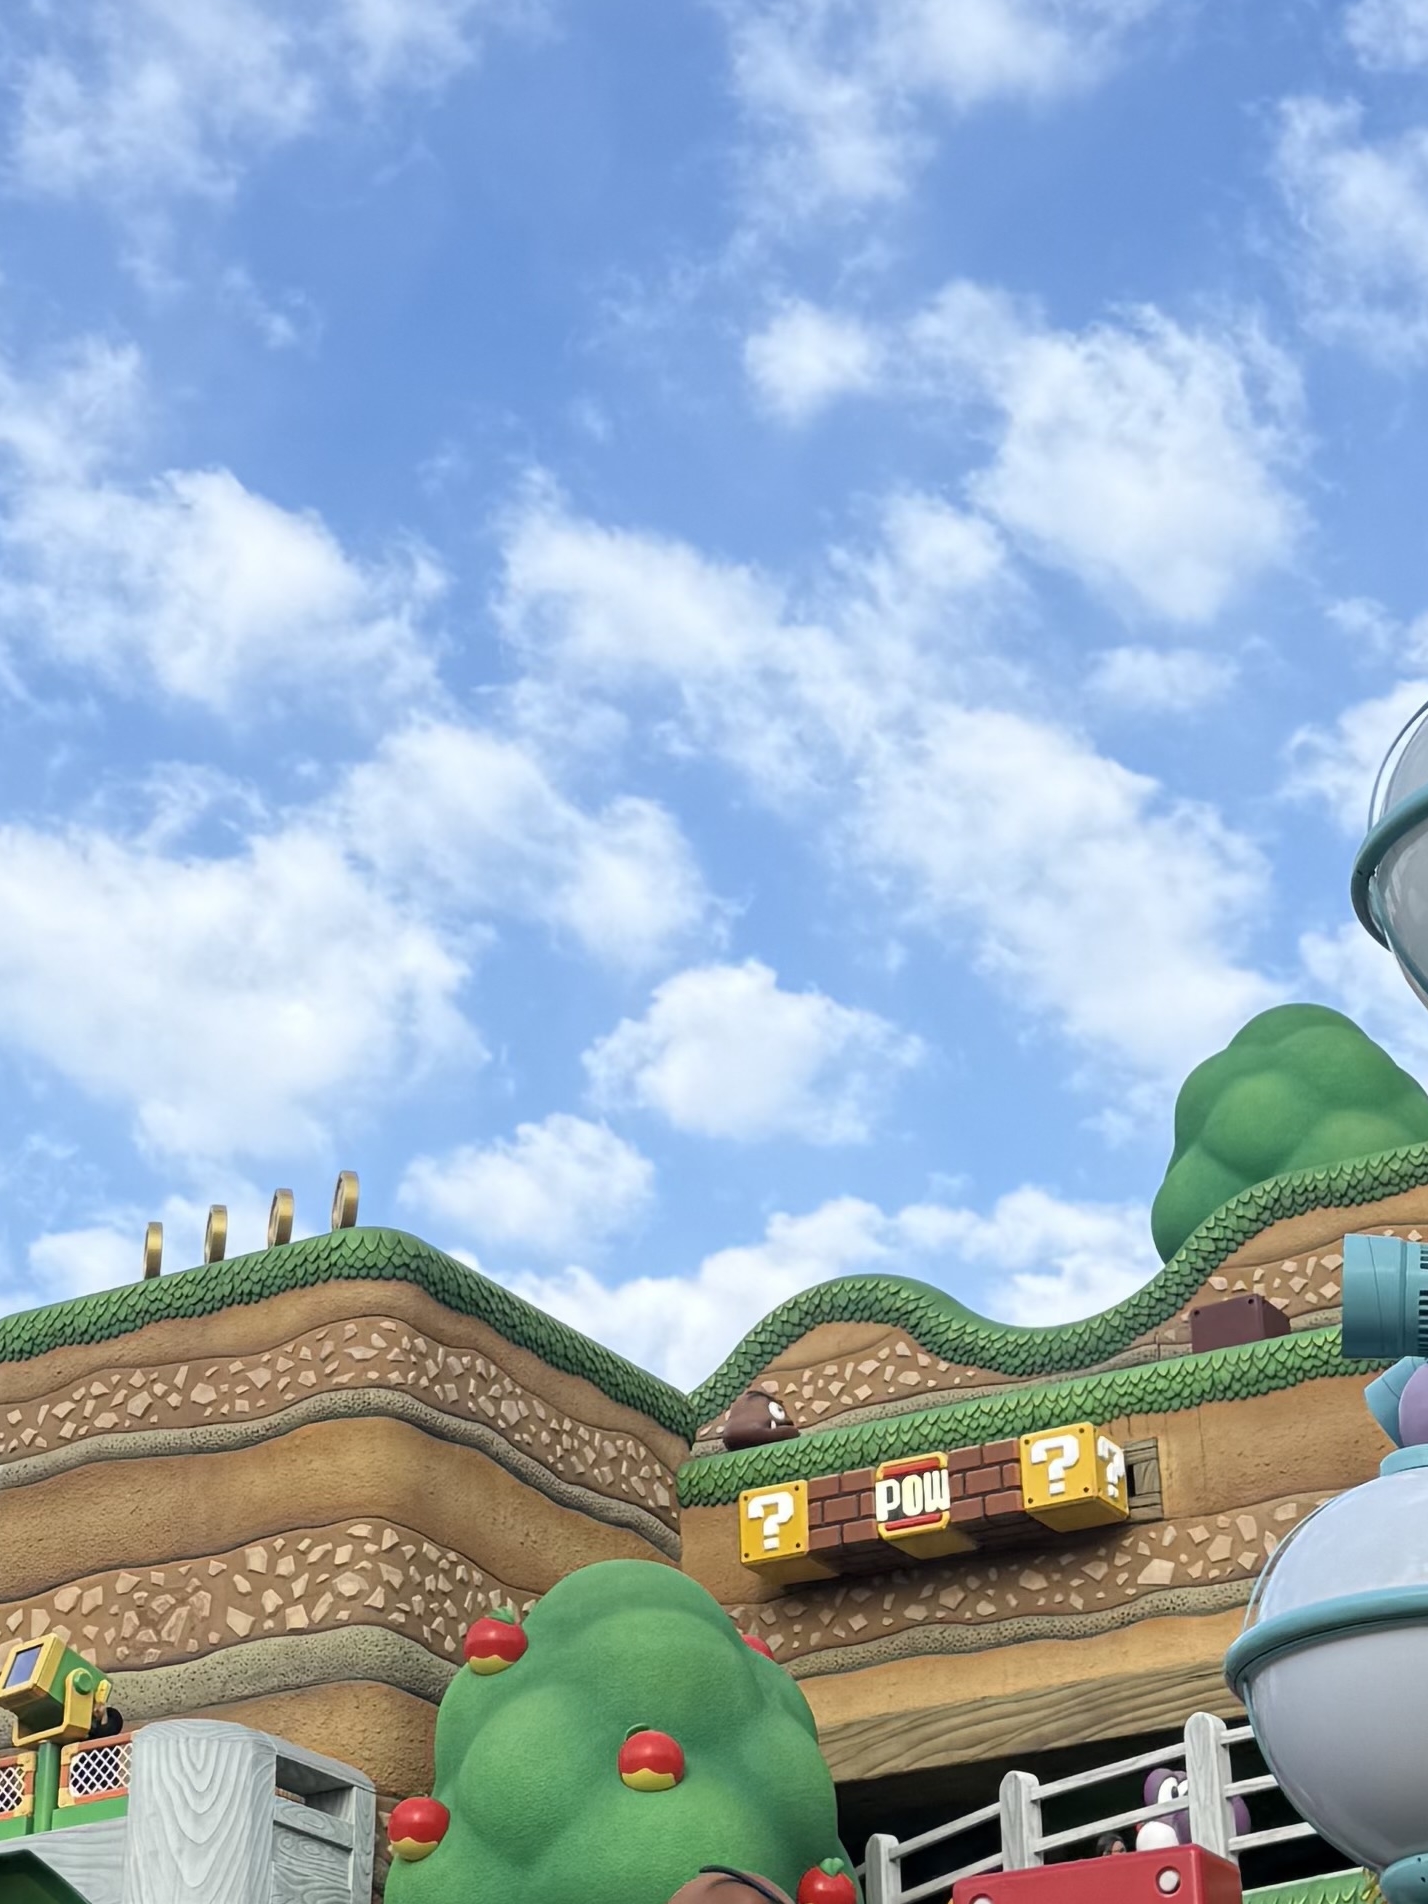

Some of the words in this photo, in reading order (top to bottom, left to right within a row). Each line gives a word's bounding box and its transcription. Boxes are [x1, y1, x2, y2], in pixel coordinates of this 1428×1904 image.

[1030, 1434, 1080, 1495] ?
[747, 1491, 794, 1551] ?
[875, 1468, 951, 1522] POW
